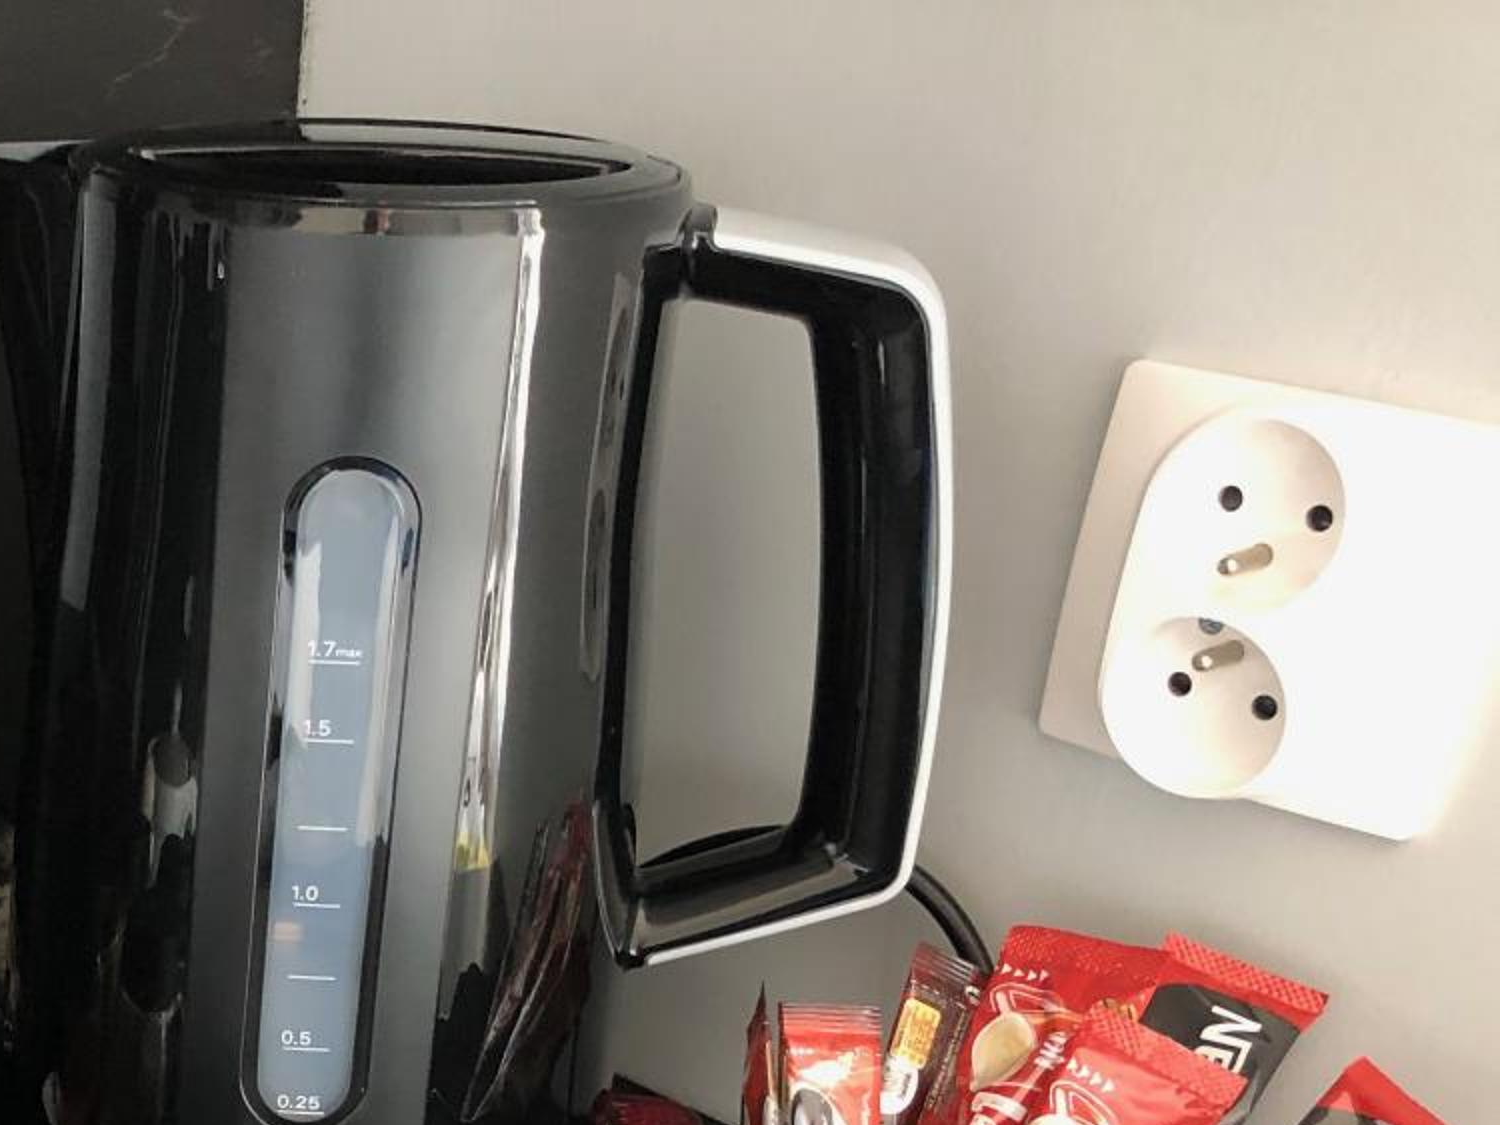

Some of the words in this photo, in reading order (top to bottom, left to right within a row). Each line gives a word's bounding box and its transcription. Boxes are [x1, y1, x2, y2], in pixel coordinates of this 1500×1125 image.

[303, 719, 332, 737] 1.5
[292, 885, 319, 902] 1.0
[281, 1029, 312, 1047] 0.5
[277, 1093, 321, 1111] 0.25
